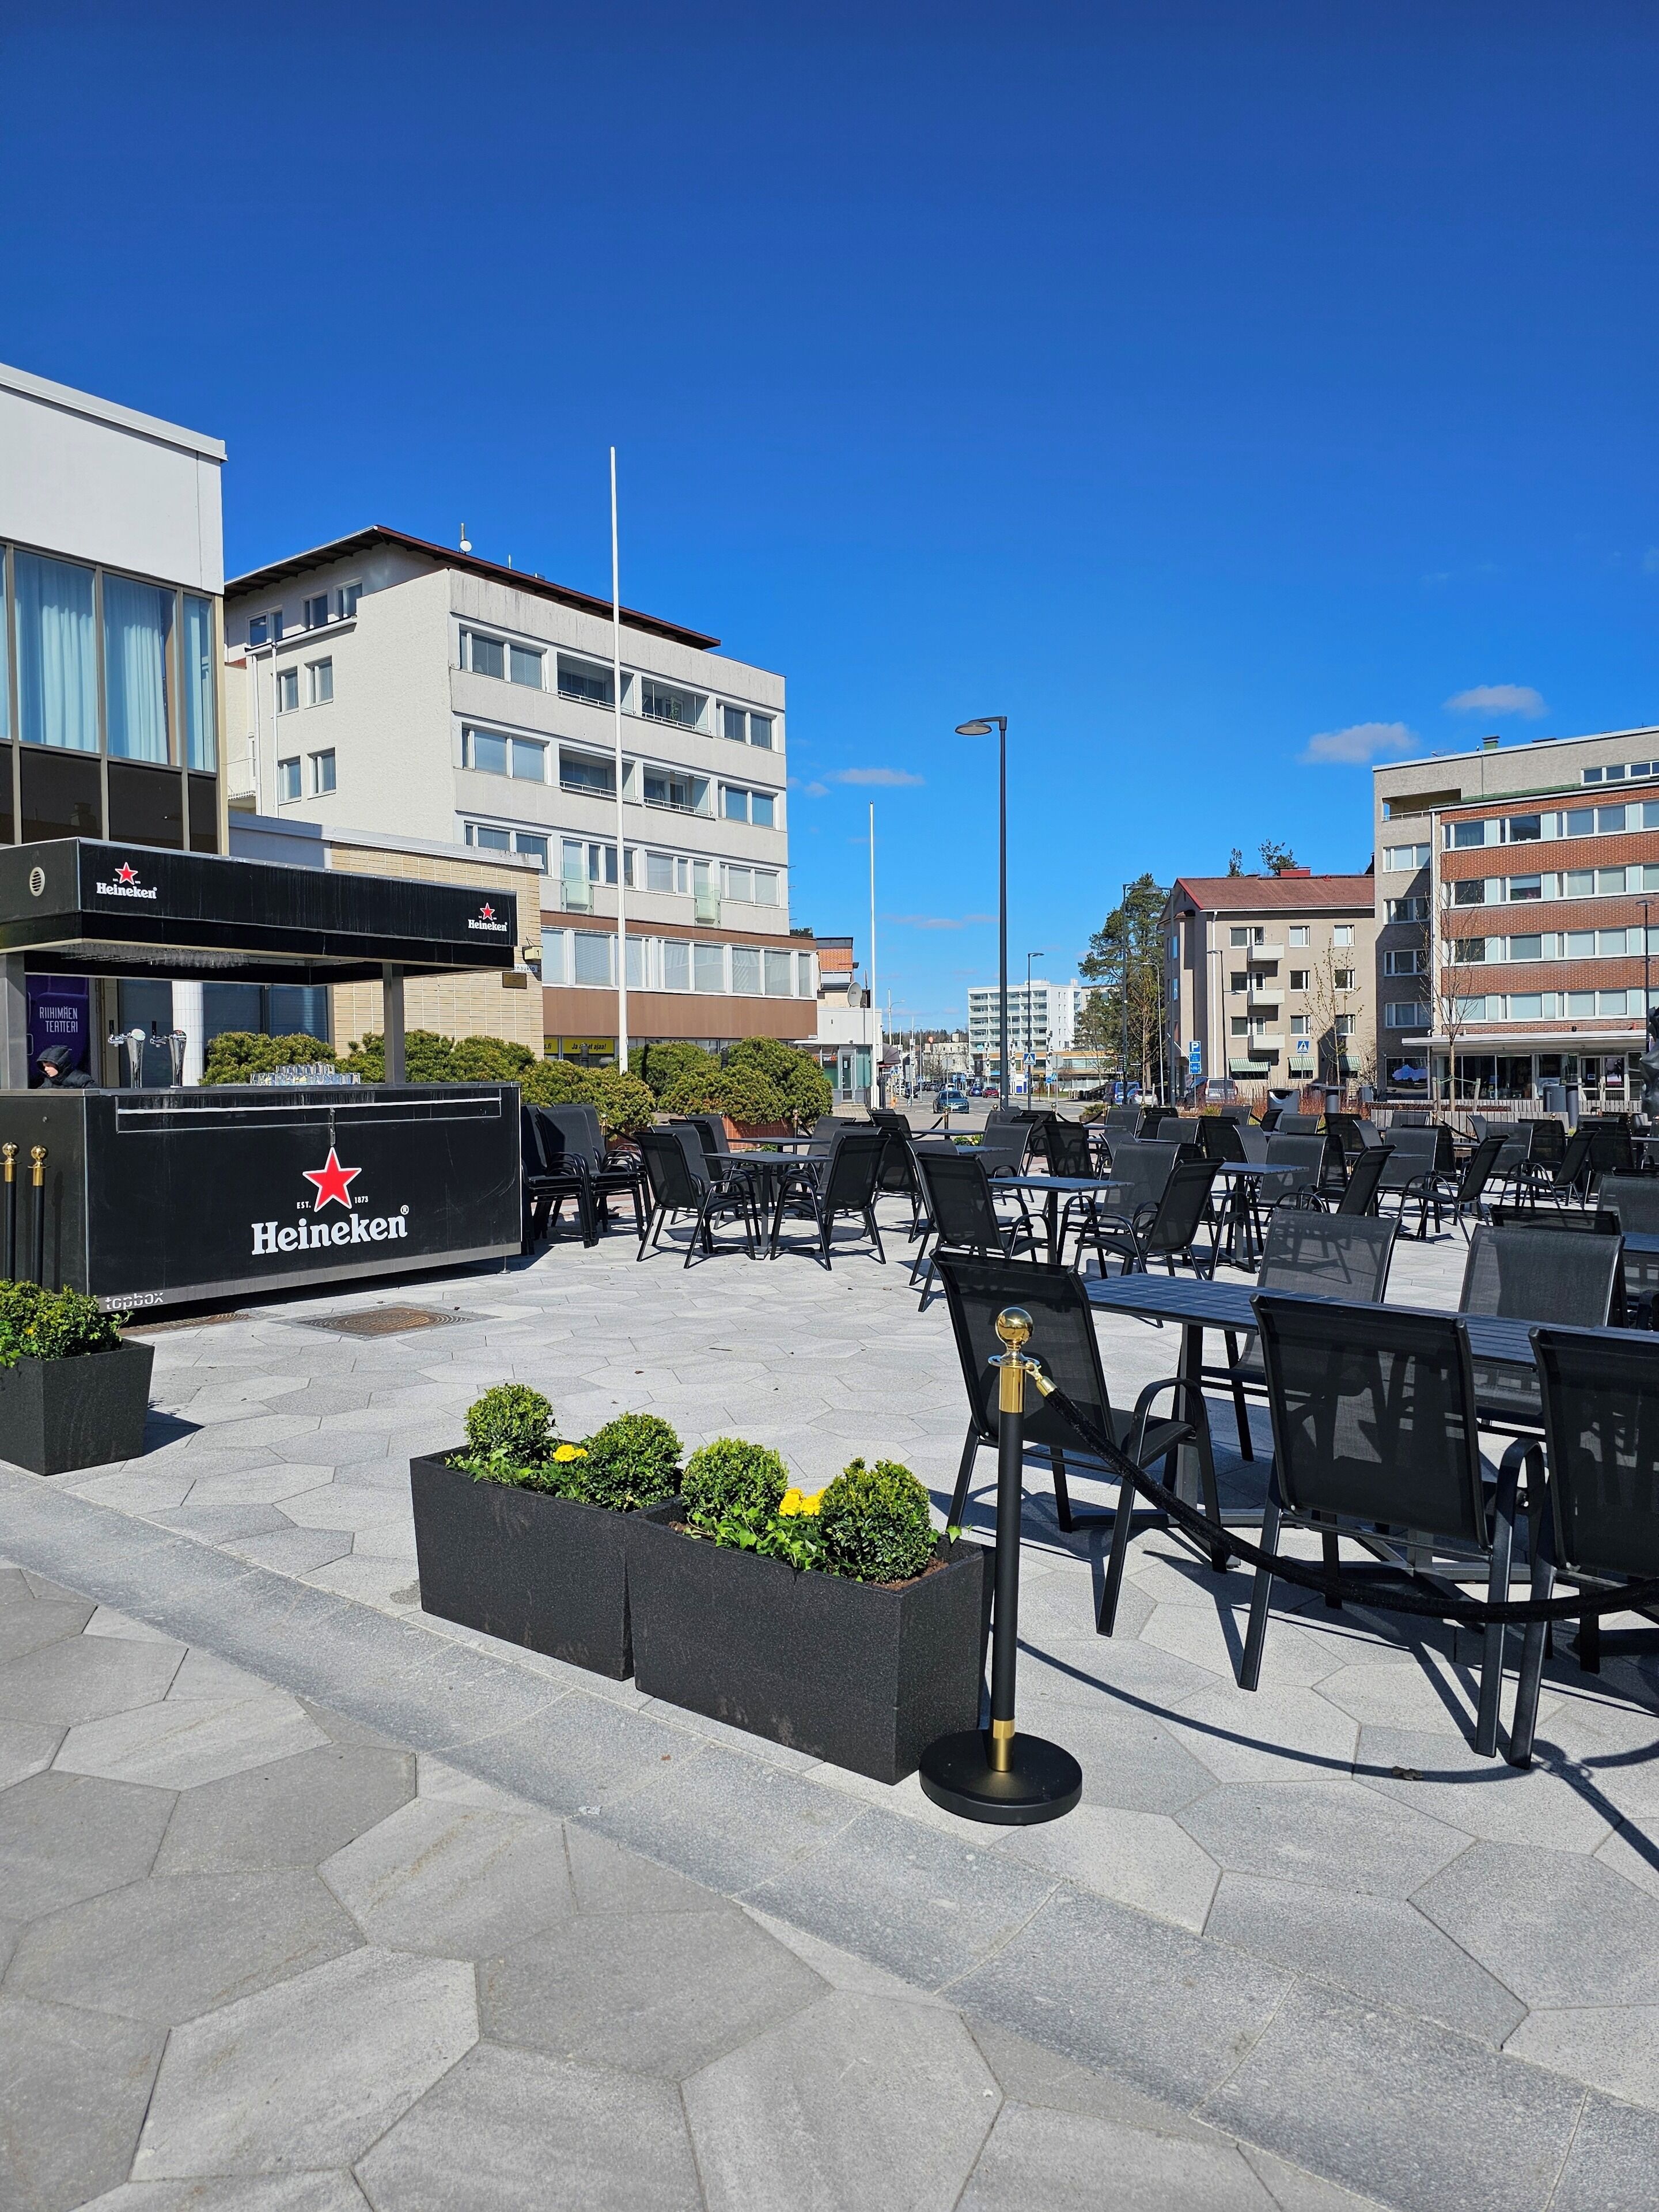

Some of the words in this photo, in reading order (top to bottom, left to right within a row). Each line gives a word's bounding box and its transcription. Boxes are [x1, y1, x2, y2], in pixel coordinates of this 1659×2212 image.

[39, 1006, 78, 1020] RIIHIMÄEN
[45, 1020, 78, 1033] TEATTERI
[1191, 1042, 1199, 1052] P
[296, 1200, 312, 1210] EST.
[354, 1195, 369, 1205] 1873
[105, 1292, 164, 1310] topbox
